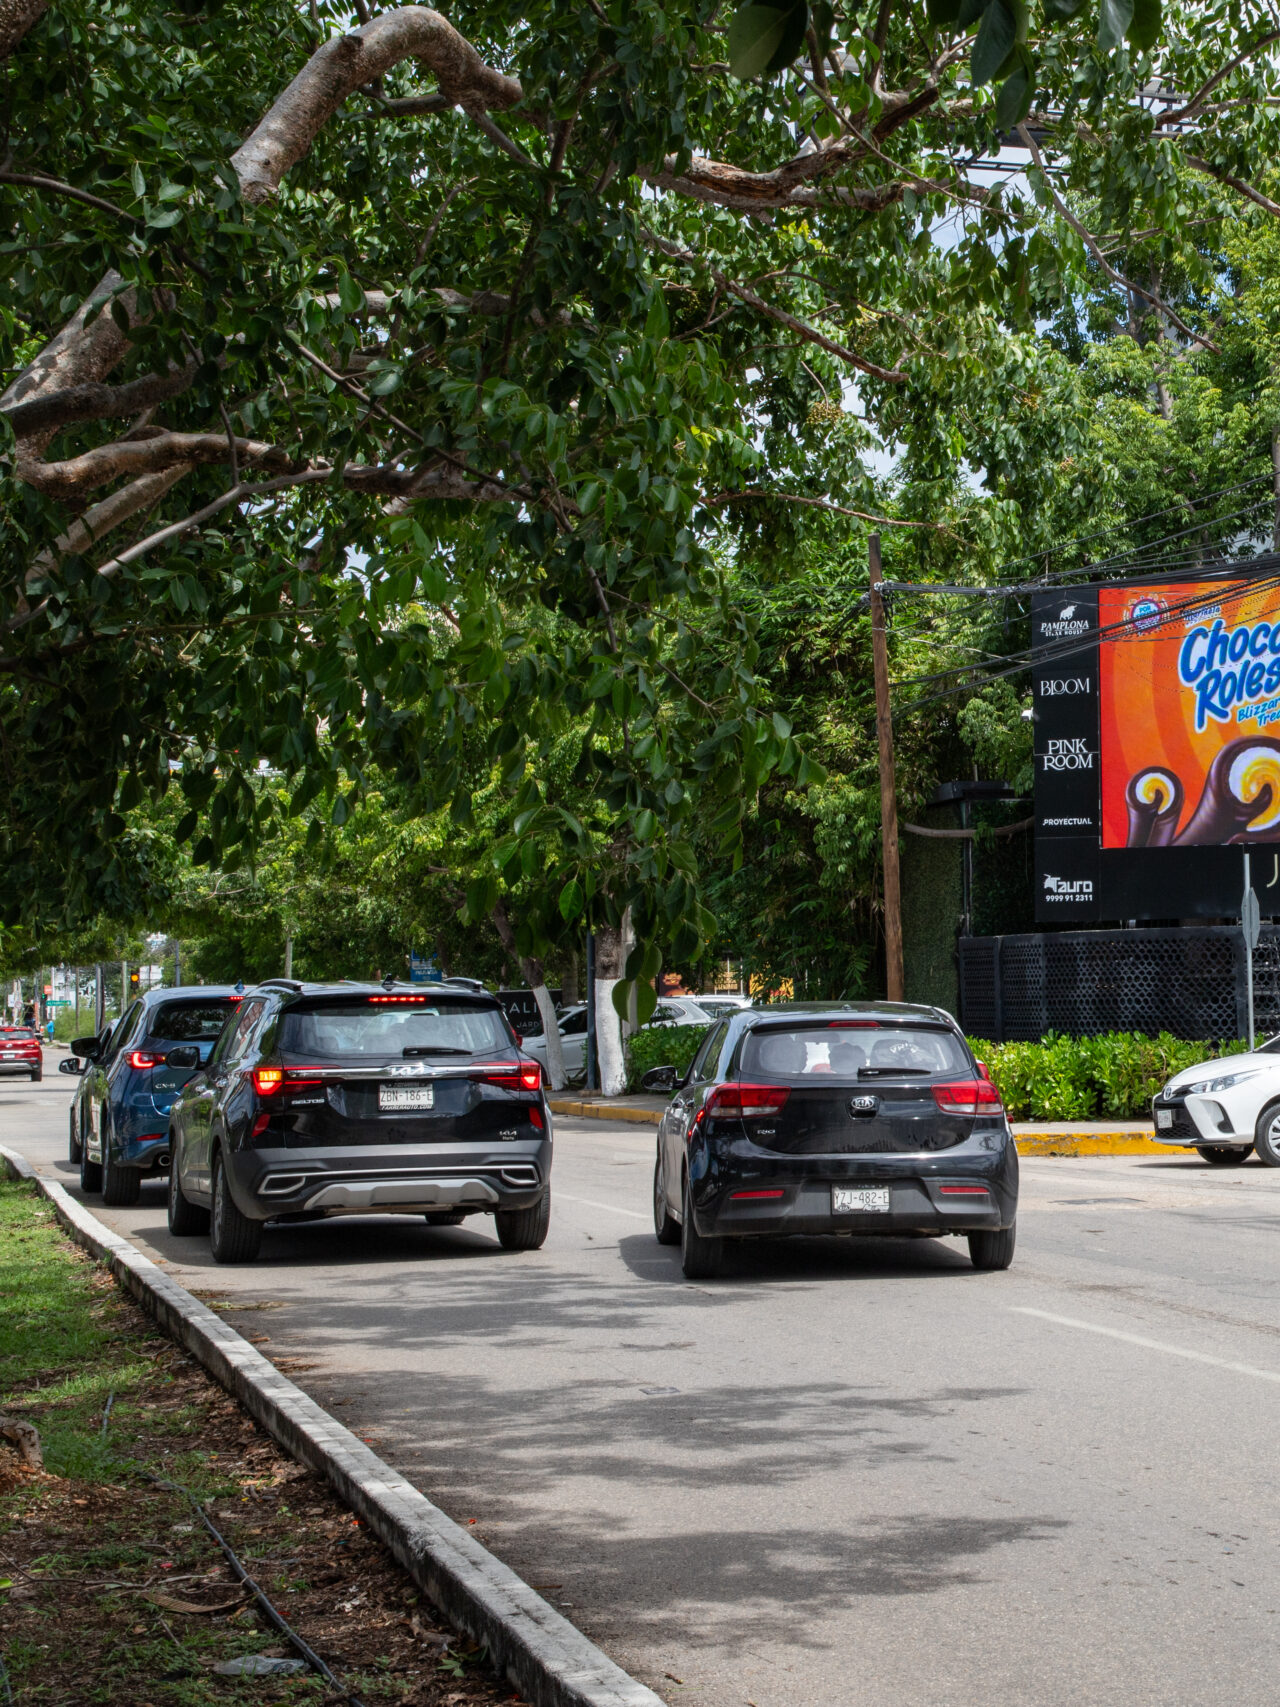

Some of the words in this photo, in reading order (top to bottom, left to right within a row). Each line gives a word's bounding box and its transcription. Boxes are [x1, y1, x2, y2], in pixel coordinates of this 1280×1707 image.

[1040, 620, 1089, 632] PAMPLONA
[1040, 678, 1090, 696] BLOOM
[1047, 738, 1089, 755] PINK
[1043, 753, 1093, 771] ROOM
[1042, 817, 1093, 826] PROYECTUAL
[1048, 876, 1093, 893] Tauro
[1045, 894, 1064, 902] 9999
[1064, 894, 1074, 902] 91
[1075, 894, 1093, 902] 2311
[501, 1002, 564, 1014] SALIA
[380, 1090, 433, 1102] ZBN-186-E
[853, 1099, 874, 1108] KIA
[834, 1191, 889, 1204] YZJ-482-E
